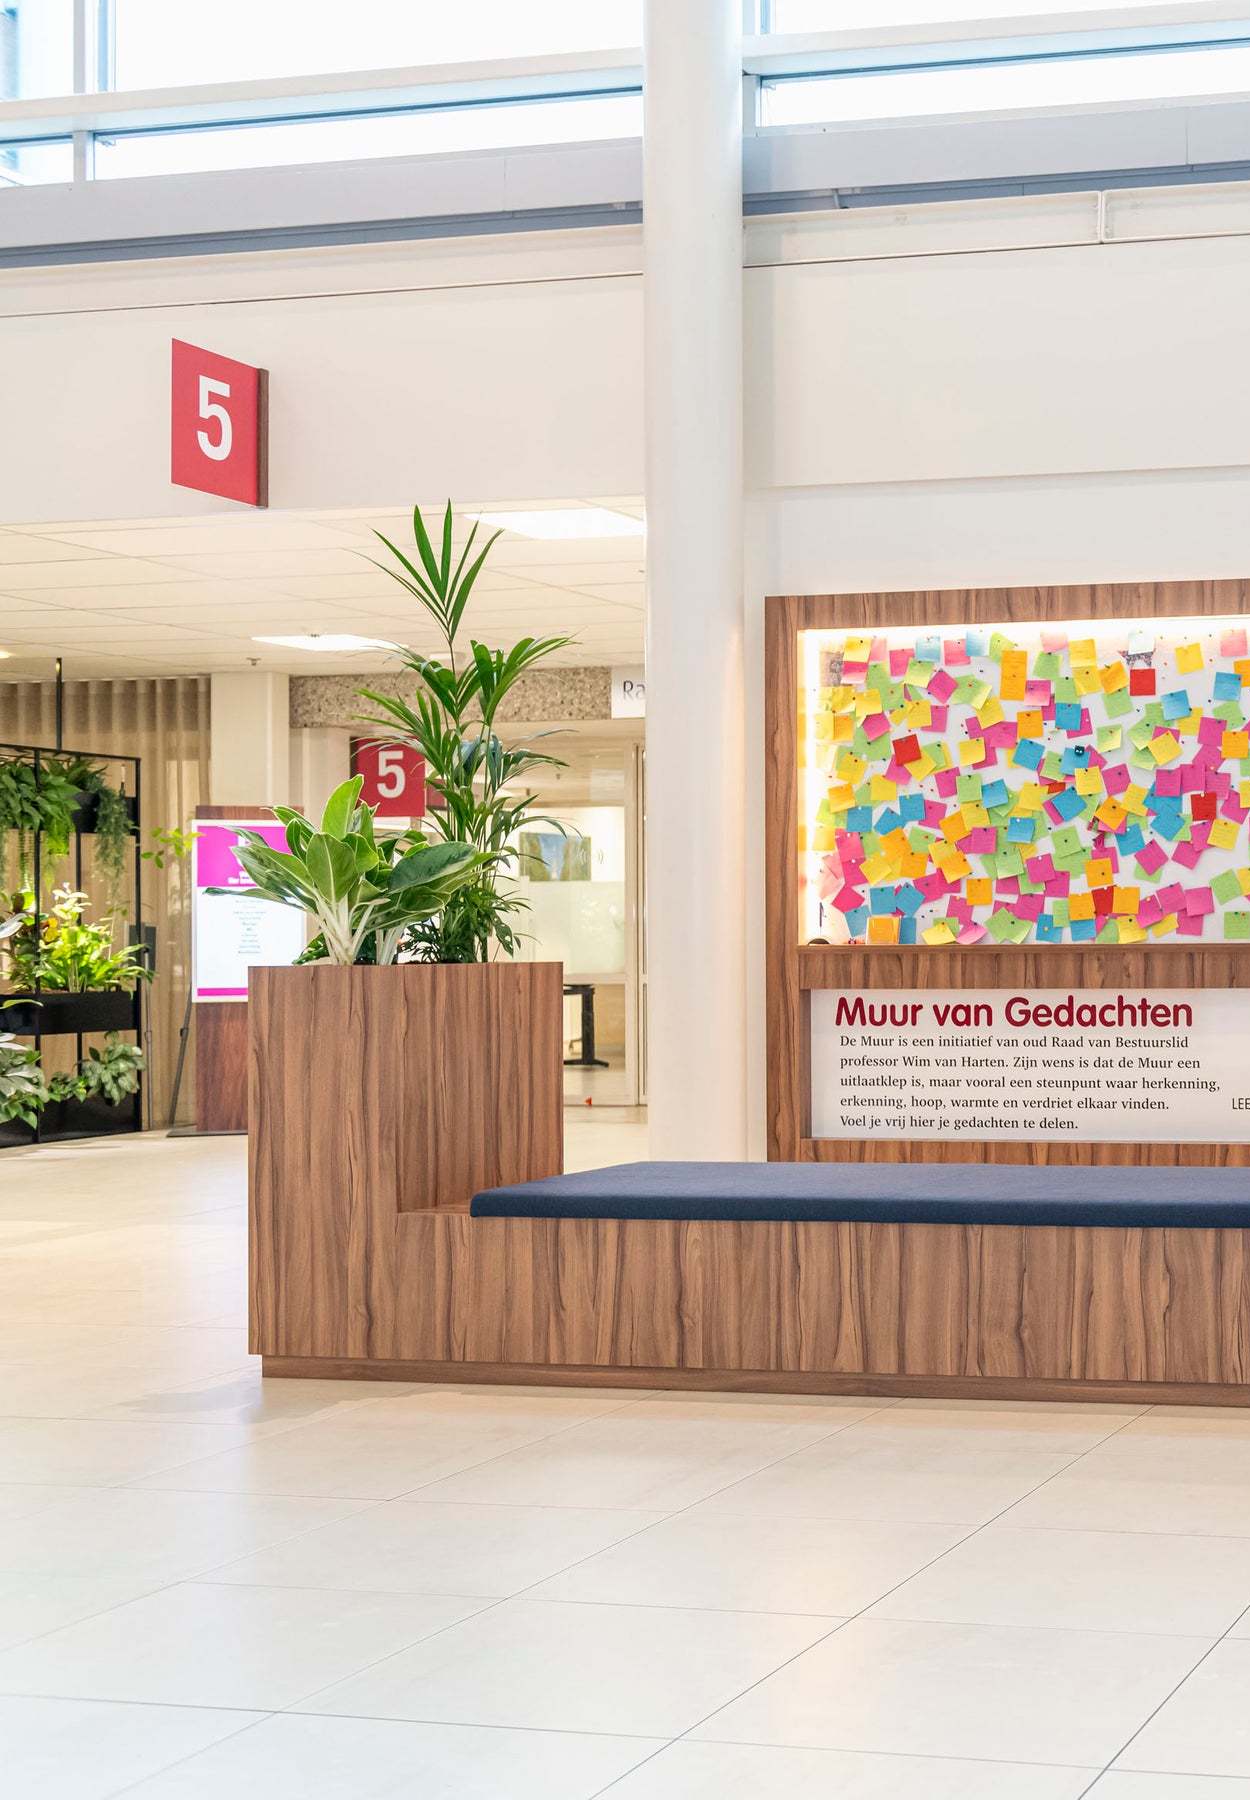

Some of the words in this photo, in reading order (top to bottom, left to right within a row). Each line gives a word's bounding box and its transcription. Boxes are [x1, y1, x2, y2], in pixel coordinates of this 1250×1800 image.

[197, 374, 233, 461] 5
[377, 751, 406, 799] 5
[835, 997, 924, 1027] Muur
[932, 1004, 993, 1027] van
[1005, 994, 1193, 1027] Gedachten
[840, 1035, 857, 1047] De
[860, 1035, 895, 1047] Muur
[898, 1035, 908, 1047] is
[911, 1037, 934, 1048] een
[938, 1035, 993, 1048] initiatief
[996, 1037, 1019, 1048] van
[1023, 1036, 1047, 1048] oud
[1051, 1036, 1084, 1048] Raad
[1088, 1038, 1111, 1048] van
[1115, 1036, 1189, 1049] Bestuurslid
[840, 1055, 899, 1069] professor
[902, 1056, 931, 1067] Wim
[934, 1058, 957, 1068] van
[960, 1056, 1009, 1068] Harten.
[1012, 1057, 1038, 1071] Zijn
[1041, 1059, 1075, 1069] wens
[1078, 1057, 1089, 1069] is
[1093, 1057, 1115, 1069] dat
[1118, 1057, 1134, 1069] de
[1137, 1057, 1174, 1069] Muur
[1177, 1059, 1201, 1069] een
[840, 1075, 907, 1090] uitlaatklep
[910, 1076, 925, 1089] is,
[928, 1078, 962, 1087] maar
[965, 1076, 1006, 1088] vooral
[1009, 1079, 1032, 1088] een
[1036, 1078, 1102, 1091] steunpunt
[1105, 1080, 1138, 1089] waar
[1142, 1077, 1221, 1093] herkenning,
[840, 1096, 907, 1109] erkenning,
[910, 1096, 946, 1110] hoop,
[950, 1097, 999, 1108] warmte
[1002, 1099, 1019, 1108] en
[1022, 1098, 1073, 1109] verdriet
[1076, 1098, 1118, 1110] elkaar
[1121, 1098, 1169, 1110] vinden.
[840, 1115, 867, 1127] Voel
[868, 1116, 882, 1130] je
[885, 1116, 906, 1130] vrij
[910, 1116, 935, 1128] hier
[937, 1117, 950, 1130] je
[953, 1116, 1019, 1131] gedachten
[1023, 1118, 1036, 1128] te
[1039, 1118, 1079, 1129] delen.
